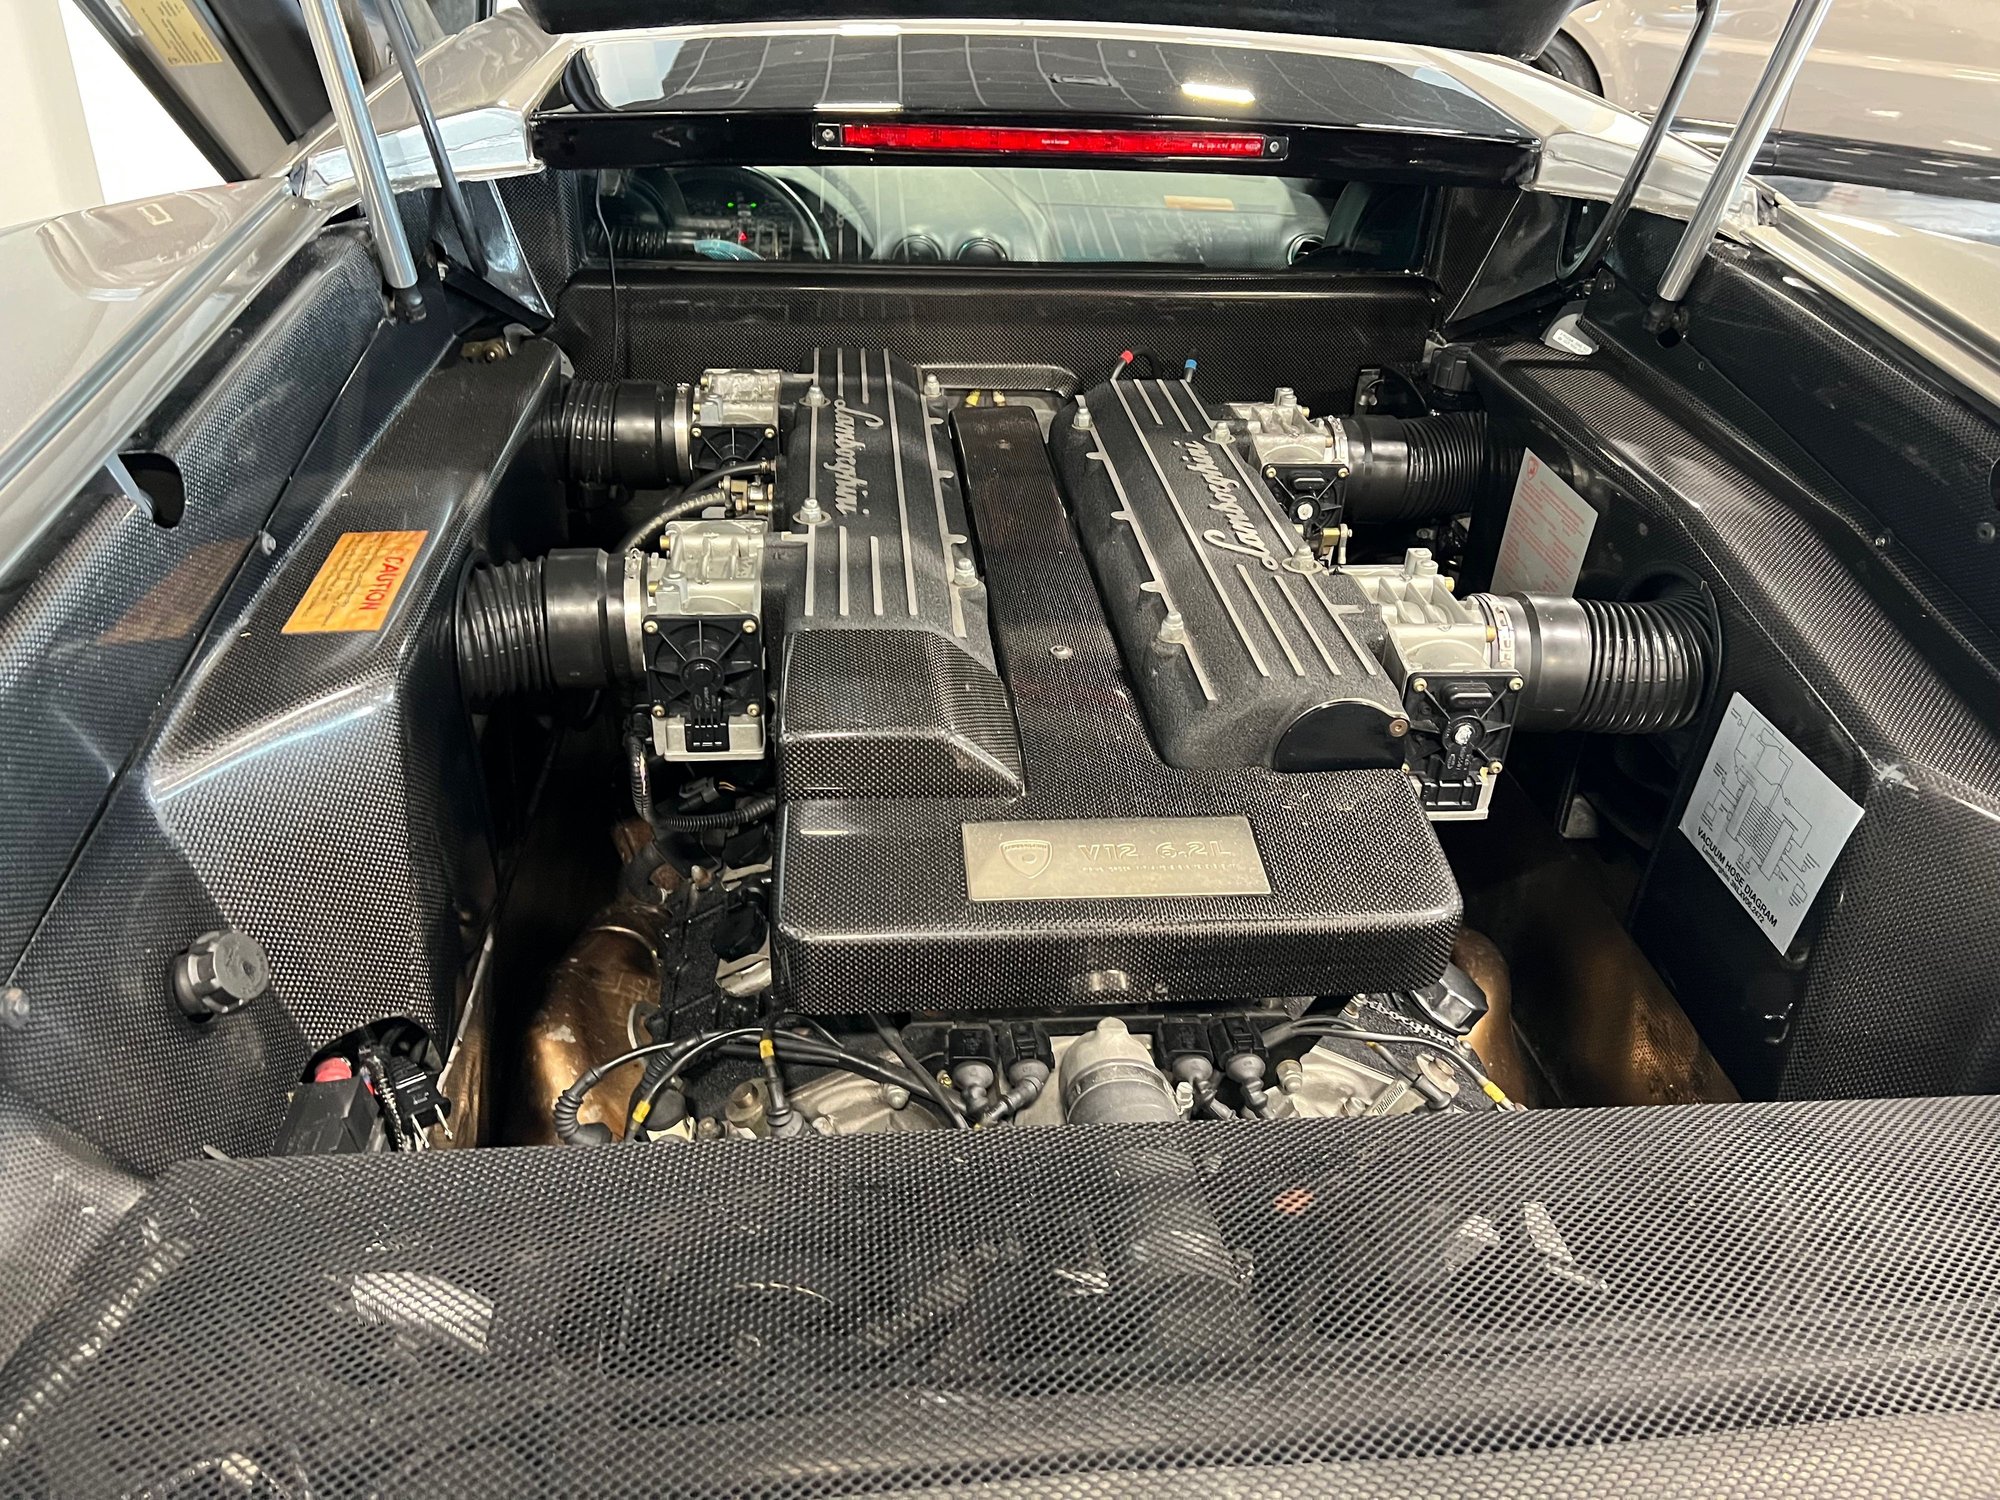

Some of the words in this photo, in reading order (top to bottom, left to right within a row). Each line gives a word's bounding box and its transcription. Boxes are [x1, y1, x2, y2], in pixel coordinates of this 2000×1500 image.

[823, 399, 884, 515] Lamborghini
[1173, 441, 1278, 570] Lamborghini
[359, 555, 404, 611] CAUTION
[1078, 842, 1138, 861] V12
[1155, 840, 1232, 858] 6.2L
[1697, 827, 1725, 864] VACUUM
[1725, 861, 1745, 888] HOSE
[1744, 884, 1778, 927] DIAGRAM
